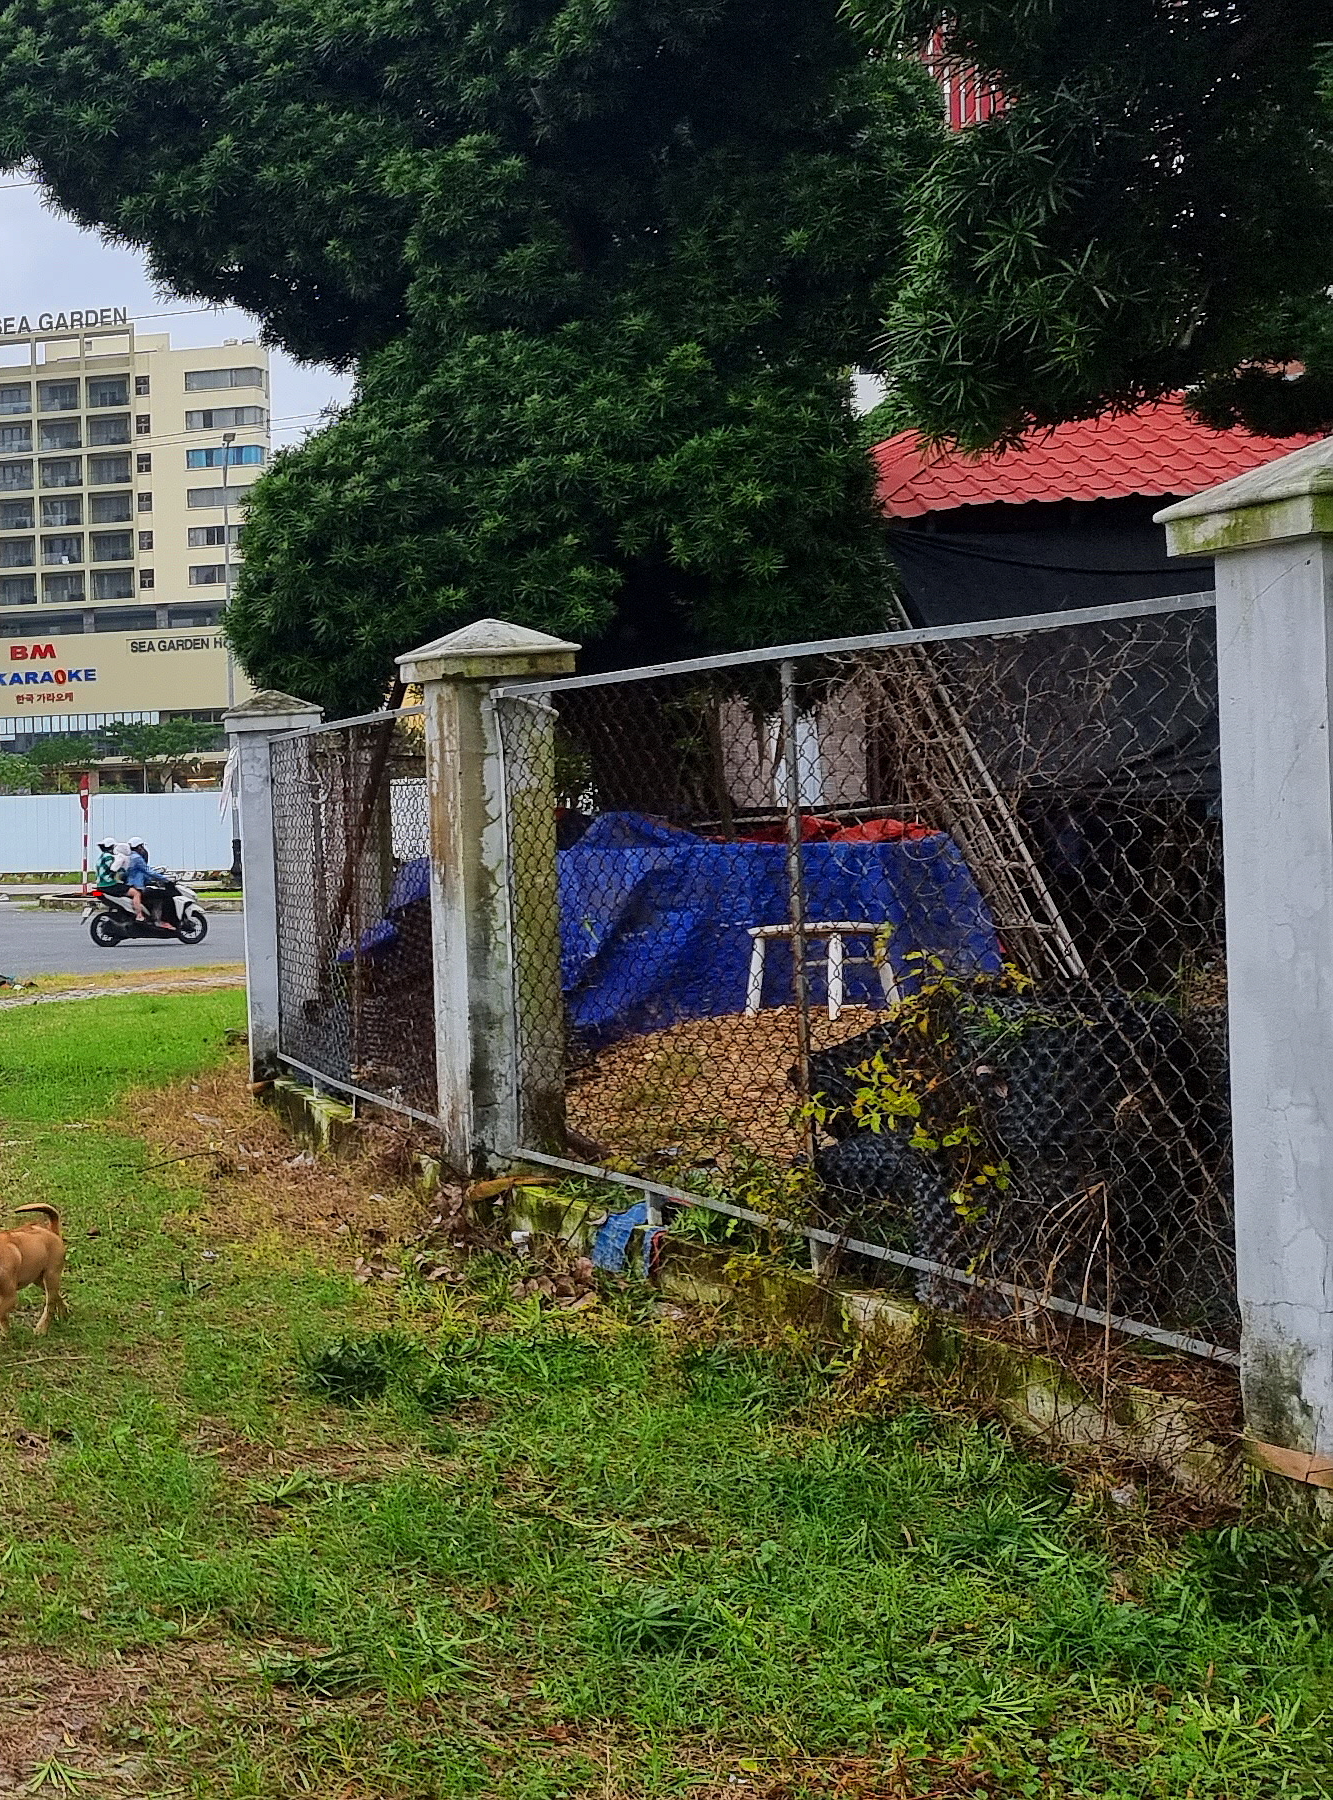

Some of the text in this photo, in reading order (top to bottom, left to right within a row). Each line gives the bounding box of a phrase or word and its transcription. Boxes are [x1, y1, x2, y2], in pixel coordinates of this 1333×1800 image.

[38, 307, 127, 330] GARDEN
[10, 644, 56, 660] BM
[130, 640, 156, 653] SEA
[158, 638, 210, 651] GARDEN
